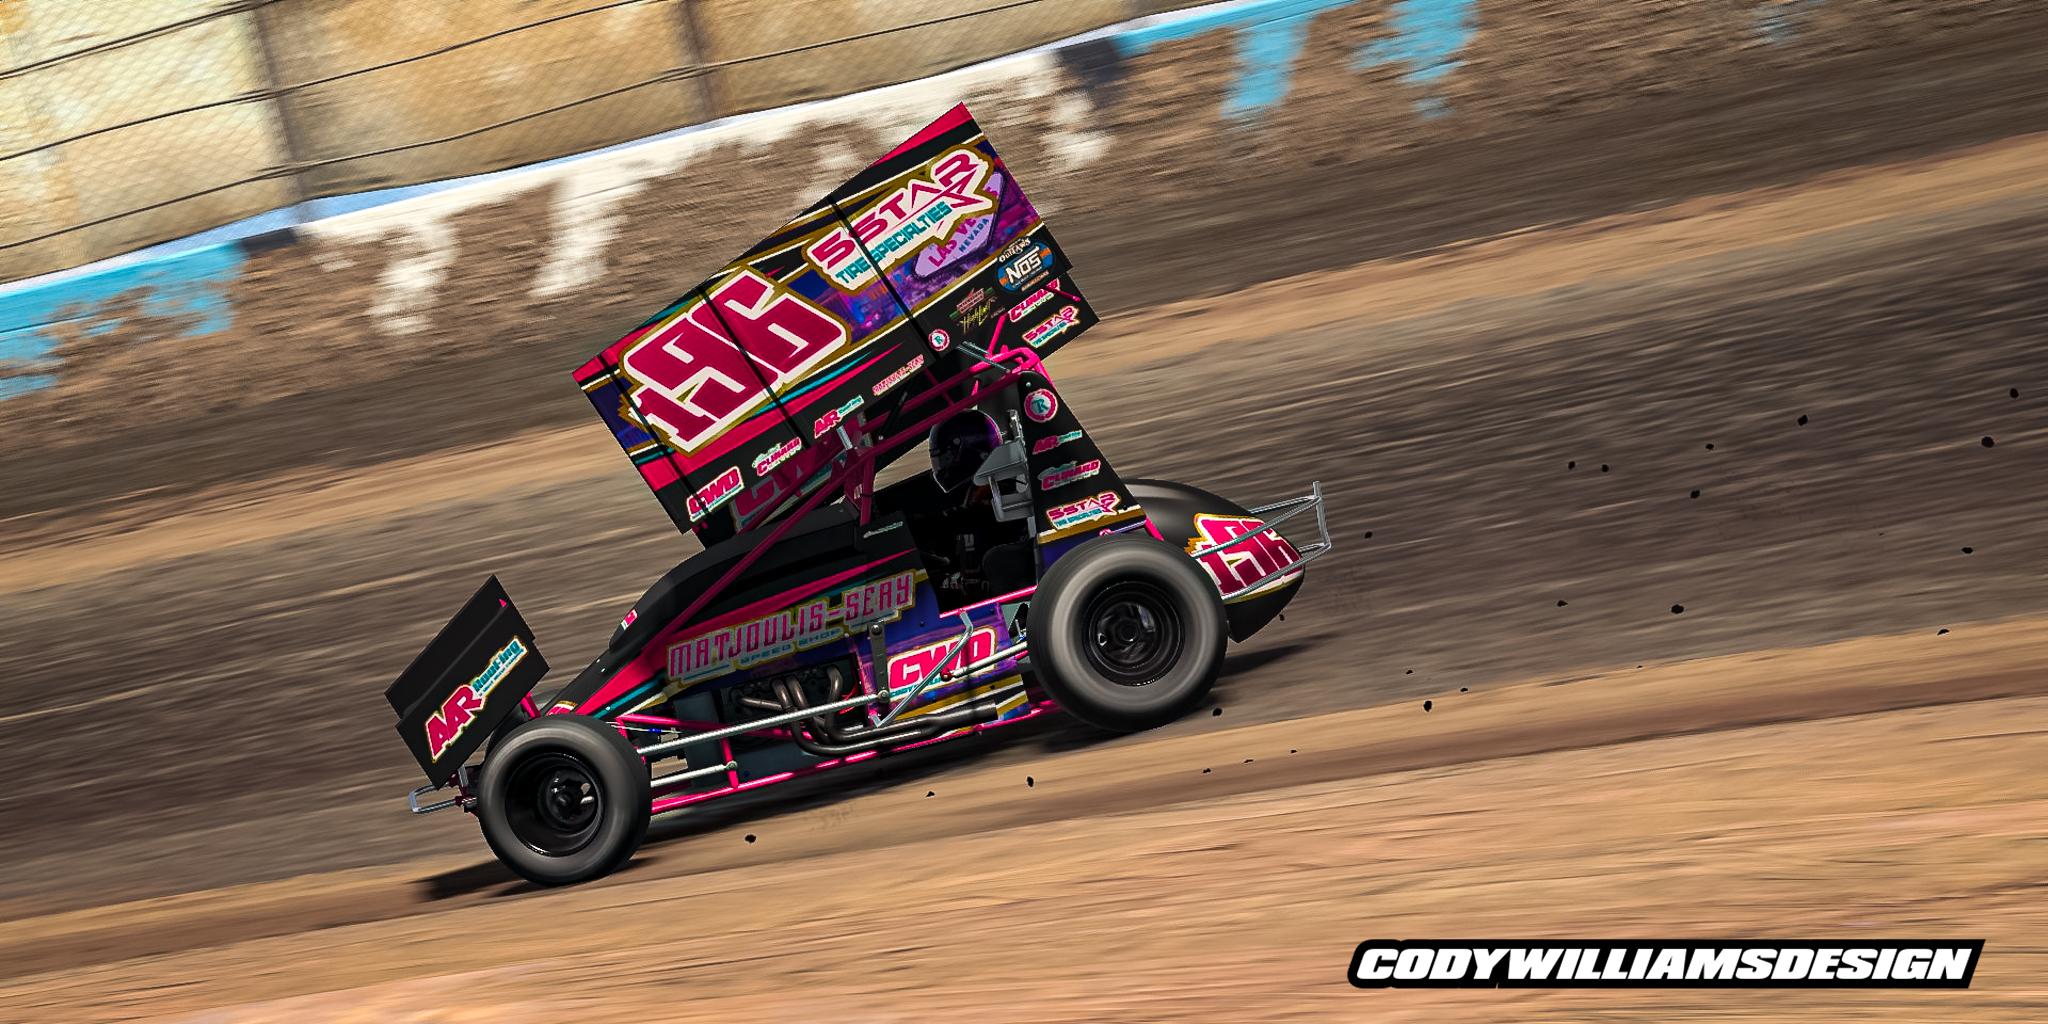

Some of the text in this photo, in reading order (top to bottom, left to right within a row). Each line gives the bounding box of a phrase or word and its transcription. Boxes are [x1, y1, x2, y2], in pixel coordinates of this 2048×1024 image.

[835, 201, 953, 285] TIRE SPECIALTIES
[958, 218, 989, 253] NEVADA
[1005, 246, 1041, 283] NOS
[625, 270, 847, 450] 196
[740, 628, 842, 664] SPEED SHOP
[890, 631, 992, 689] CWD
[426, 686, 483, 759] AAR
